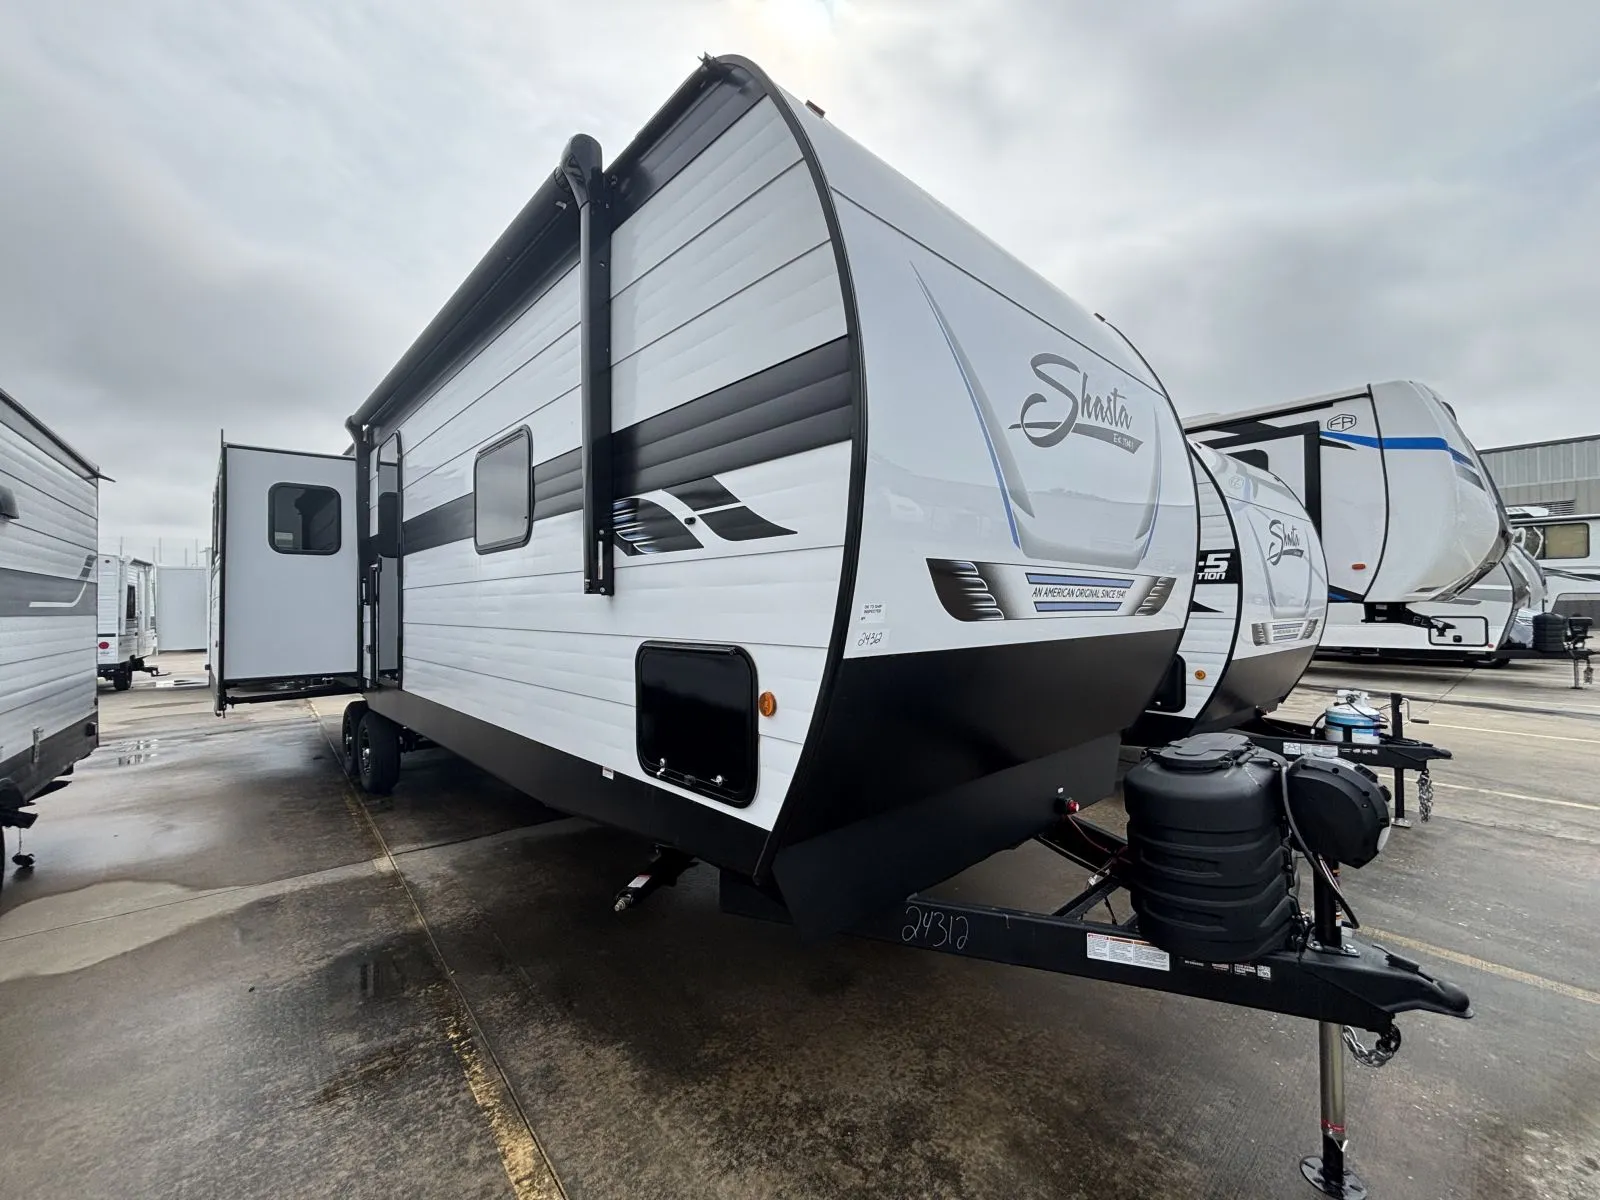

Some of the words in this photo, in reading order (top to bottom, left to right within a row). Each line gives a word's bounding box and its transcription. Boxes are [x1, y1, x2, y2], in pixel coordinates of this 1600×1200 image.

[1020, 352, 1133, 448] Shasta
[1268, 519, 1300, 566] Shasta
[1031, 587, 1043, 598] AN
[1043, 587, 1076, 598] AMERICAN
[1075, 588, 1100, 599] ORIGINAL
[1101, 589, 1116, 599] SINCE
[901, 905, 969, 950] 24312
